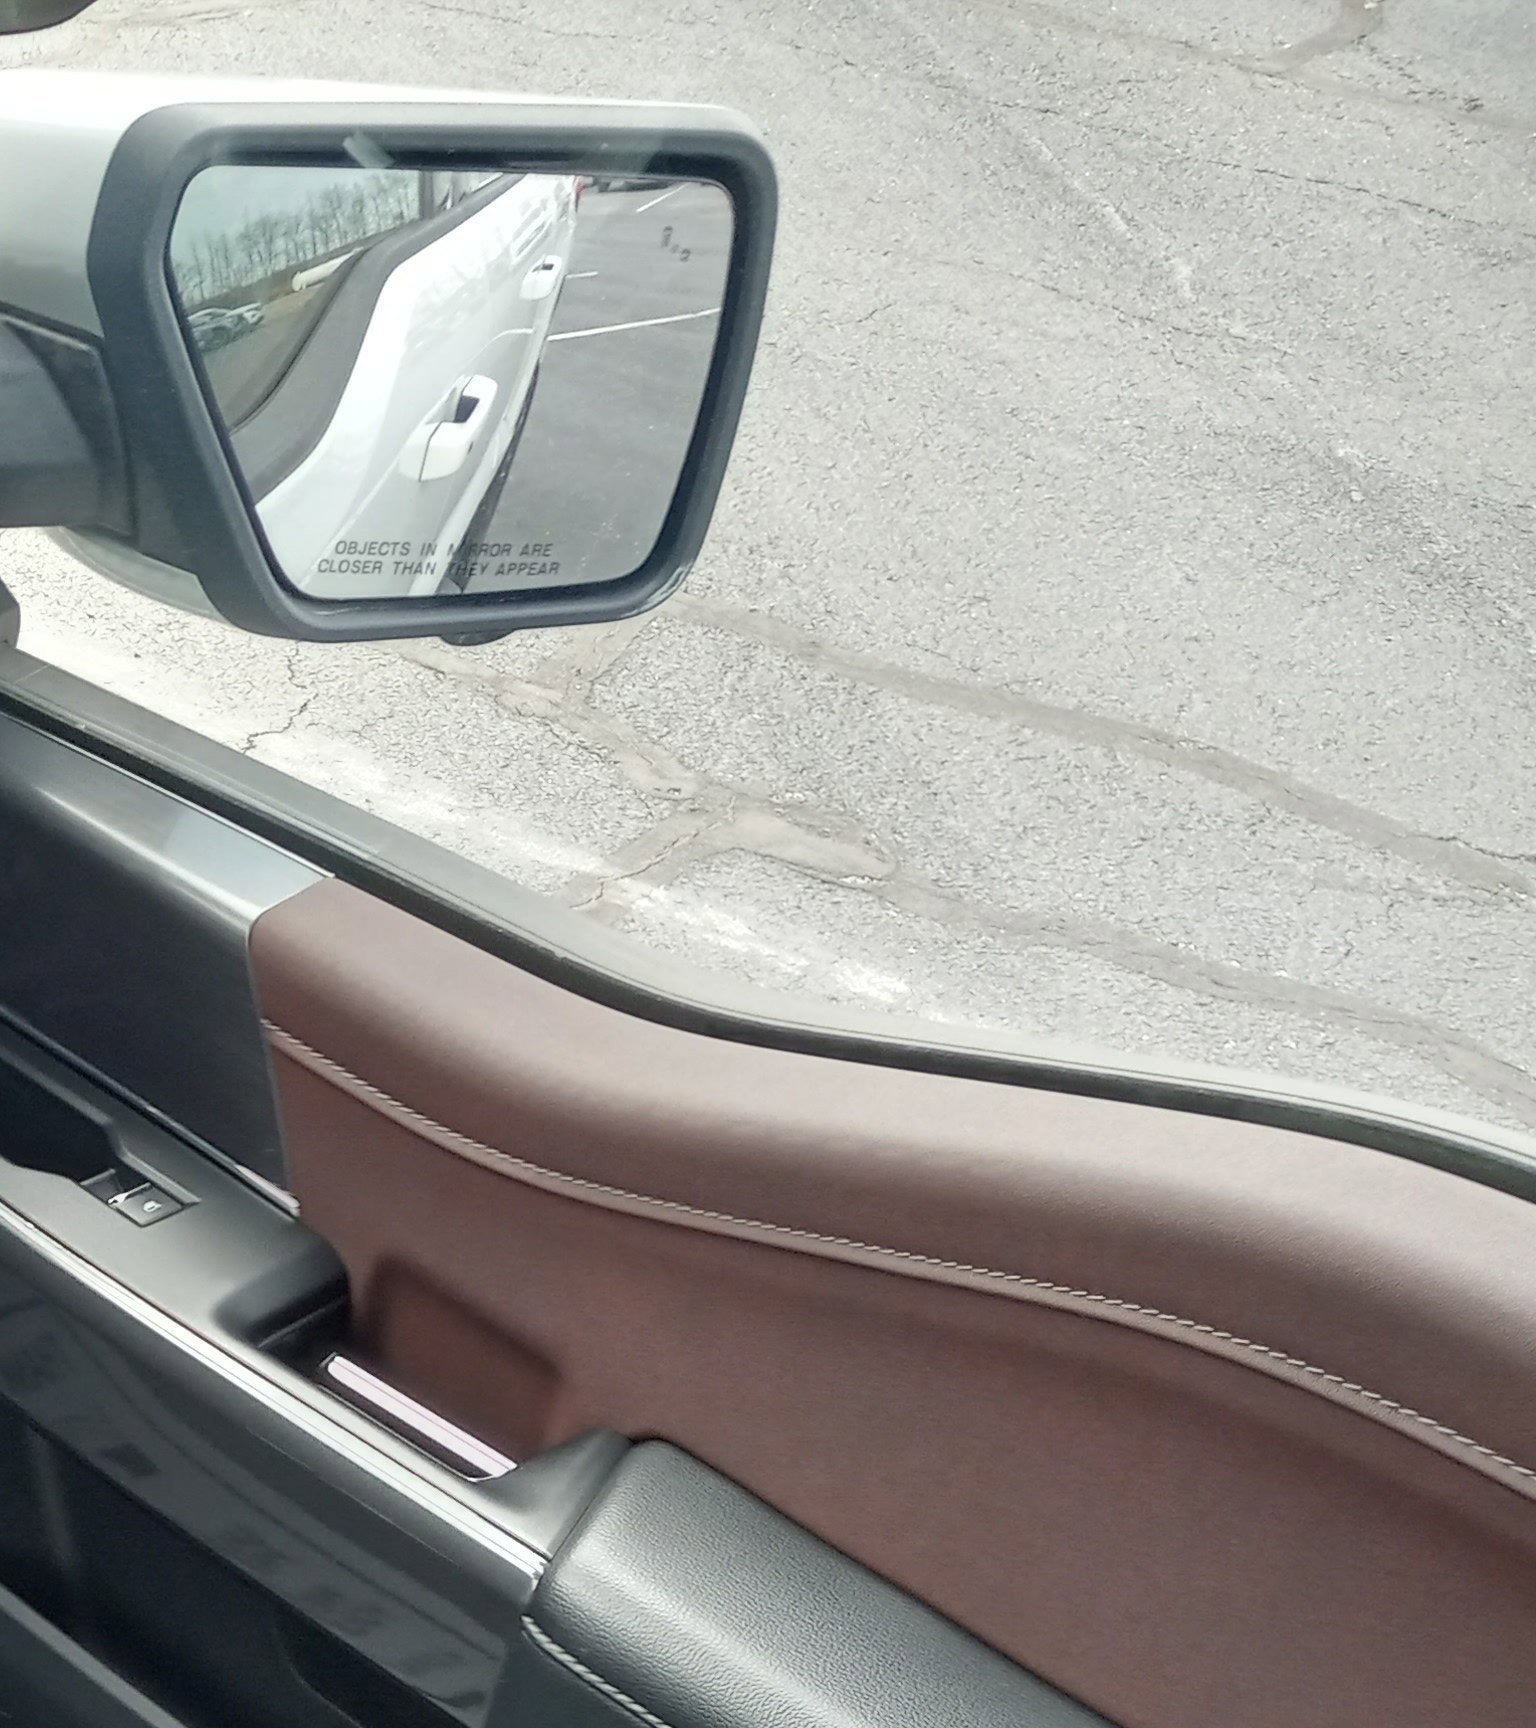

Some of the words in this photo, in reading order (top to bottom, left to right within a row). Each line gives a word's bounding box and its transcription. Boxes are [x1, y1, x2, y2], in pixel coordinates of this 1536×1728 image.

[334, 540, 411, 556] OBJECTS
[418, 543, 437, 556] IN
[446, 543, 512, 557] RROR
[519, 543, 553, 557] ARE
[317, 559, 383, 574] CLOSER
[392, 561, 437, 576] THAN
[449, 561, 490, 577] THEY
[494, 562, 561, 576] APPEAR
